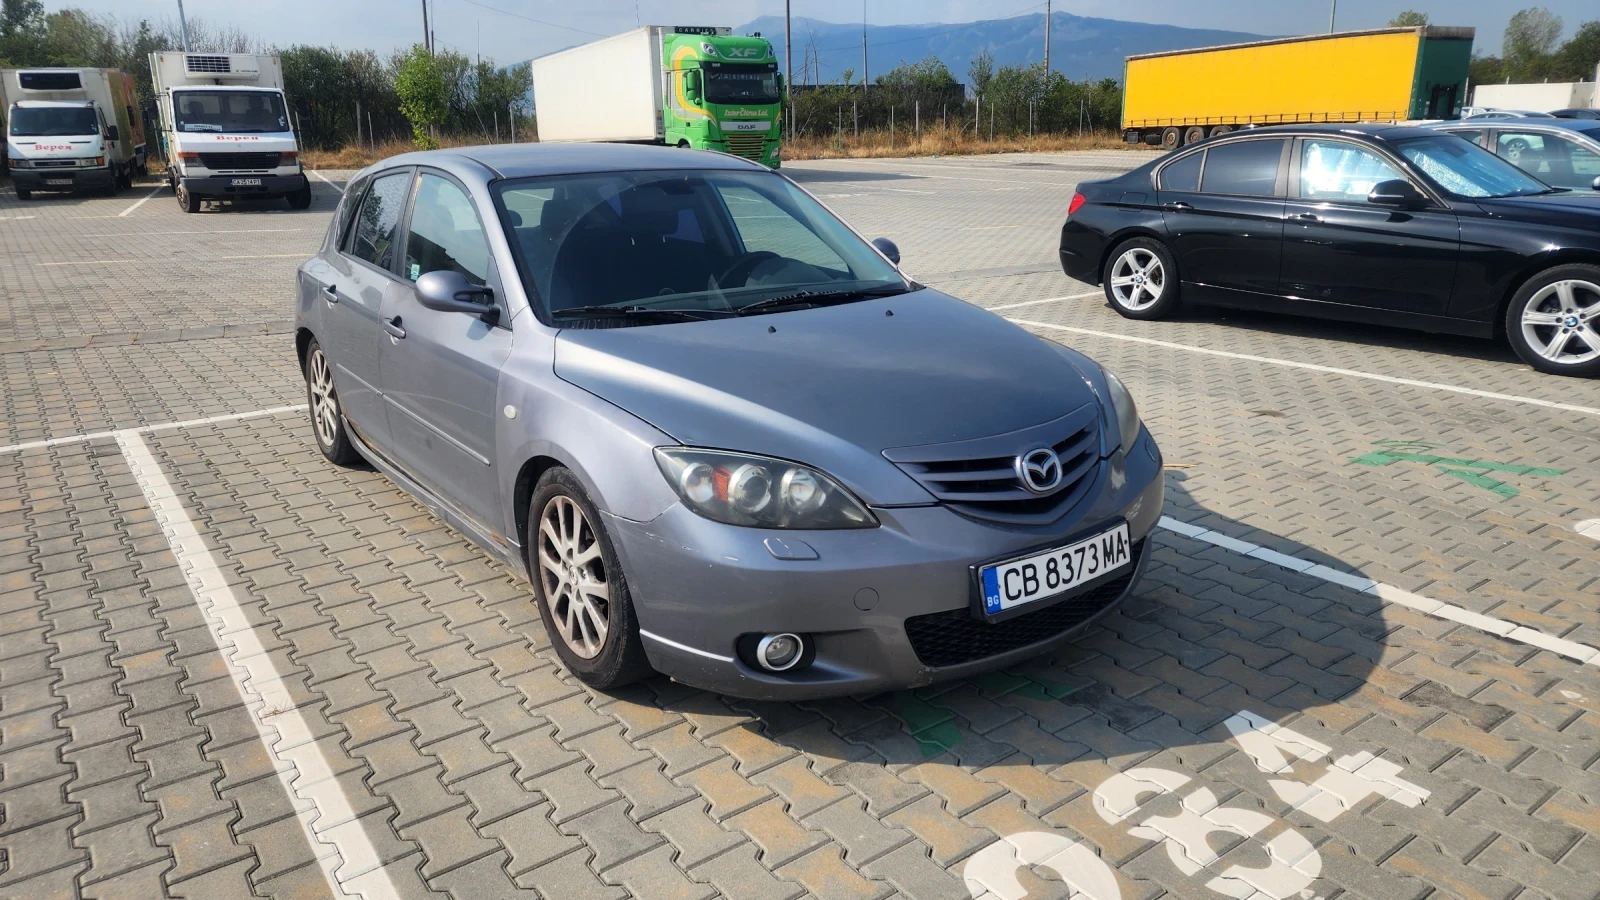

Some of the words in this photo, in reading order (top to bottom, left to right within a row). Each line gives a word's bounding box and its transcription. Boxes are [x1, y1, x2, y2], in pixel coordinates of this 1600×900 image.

[729, 47, 757, 57] XF
[34, 144, 72, 152] Верея
[1003, 563, 1040, 601] CB
[1045, 543, 1099, 590] 8373
[1102, 531, 1127, 569] MA
[987, 594, 1000, 607] BG
